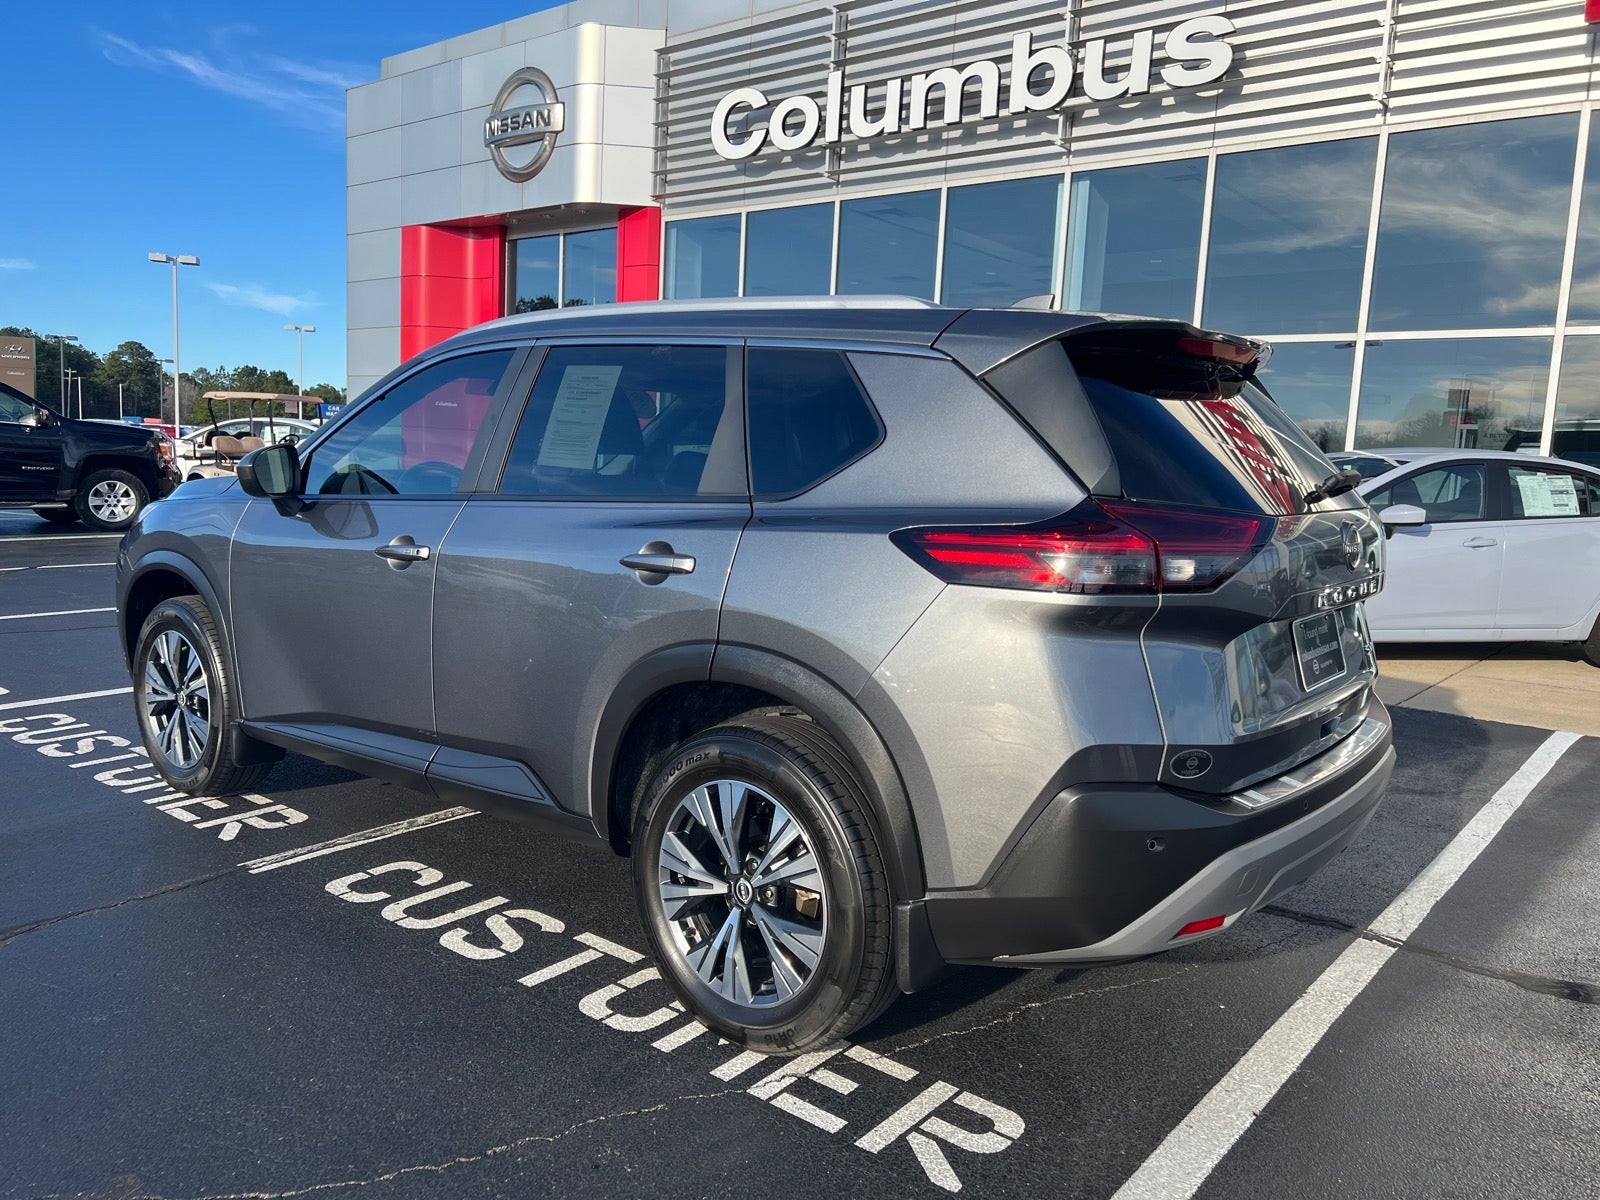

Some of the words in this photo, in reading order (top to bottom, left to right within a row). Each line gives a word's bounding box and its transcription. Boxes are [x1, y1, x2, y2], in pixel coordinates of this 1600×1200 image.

[710, 15, 1237, 160] Columbus
[485, 108, 552, 139] NISSAN
[1317, 579, 1377, 608] ROGUE
[685, 751, 711, 767] max
